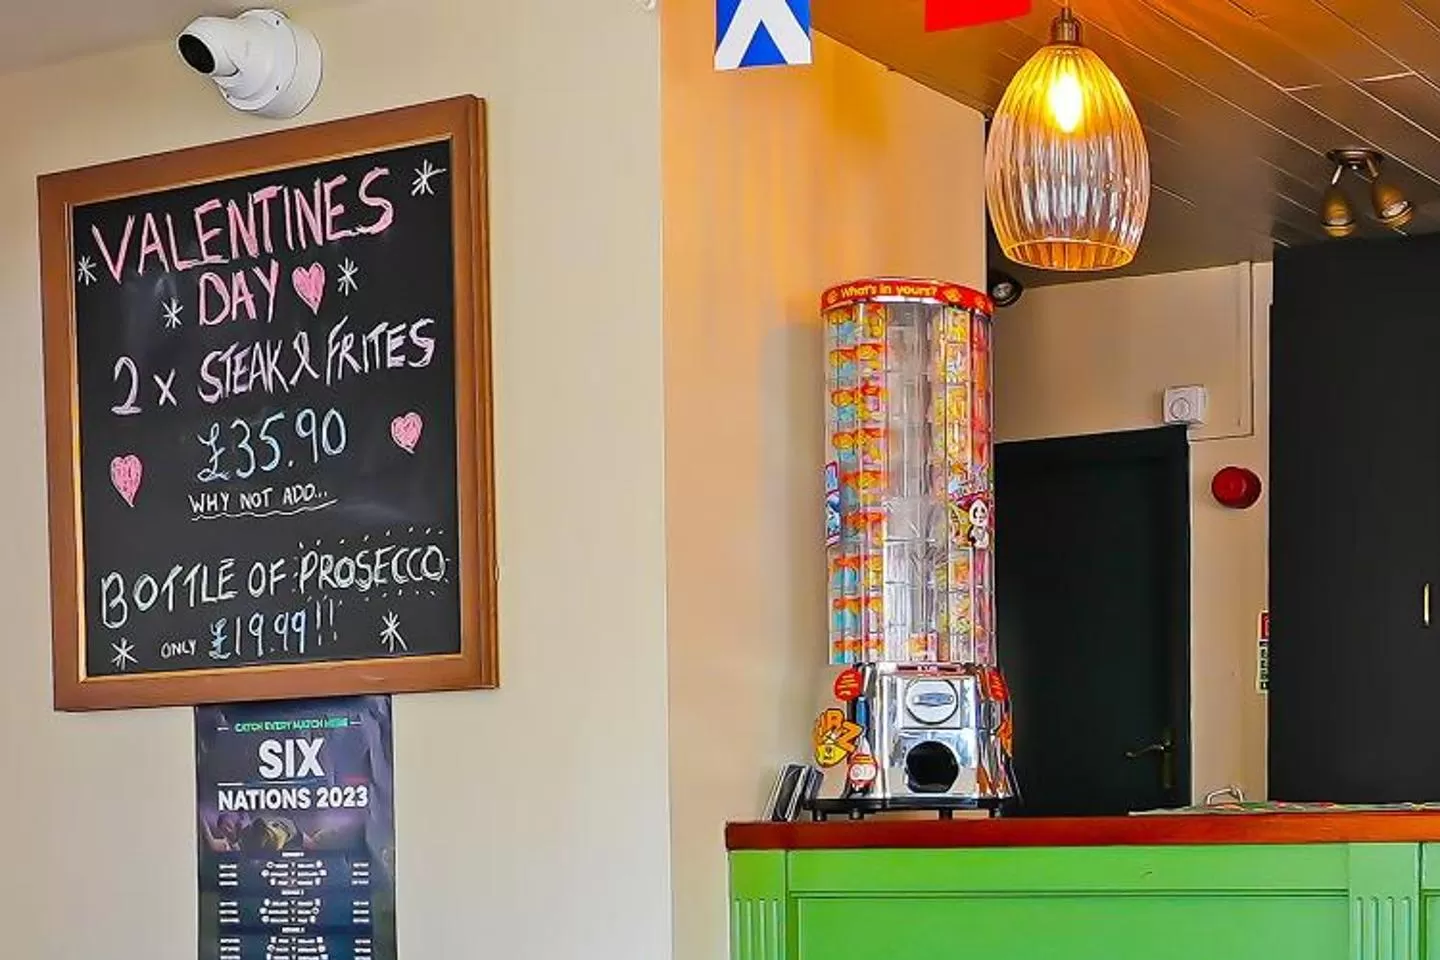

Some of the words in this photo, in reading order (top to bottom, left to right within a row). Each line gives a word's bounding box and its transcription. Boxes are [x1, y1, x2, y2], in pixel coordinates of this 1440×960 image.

[92, 167, 394, 284] VALENTINES
[199, 259, 280, 325] DAY
[879, 283, 891, 294] in
[111, 356, 142, 415] 2
[198, 339, 290, 404] STEAK
[325, 315, 436, 386] FRITES
[197, 408, 347, 482] £35.90
[188, 492, 230, 513] WHY
[240, 487, 274, 510] NOT
[101, 558, 238, 629] BOTTLE
[249, 558, 286, 604] OF
[299, 545, 446, 594] PROSECCO
[161, 639, 198, 659] ONLY
[258, 737, 325, 779] SIX
[218, 788, 310, 811] NATIONS
[316, 785, 368, 808] 2023
